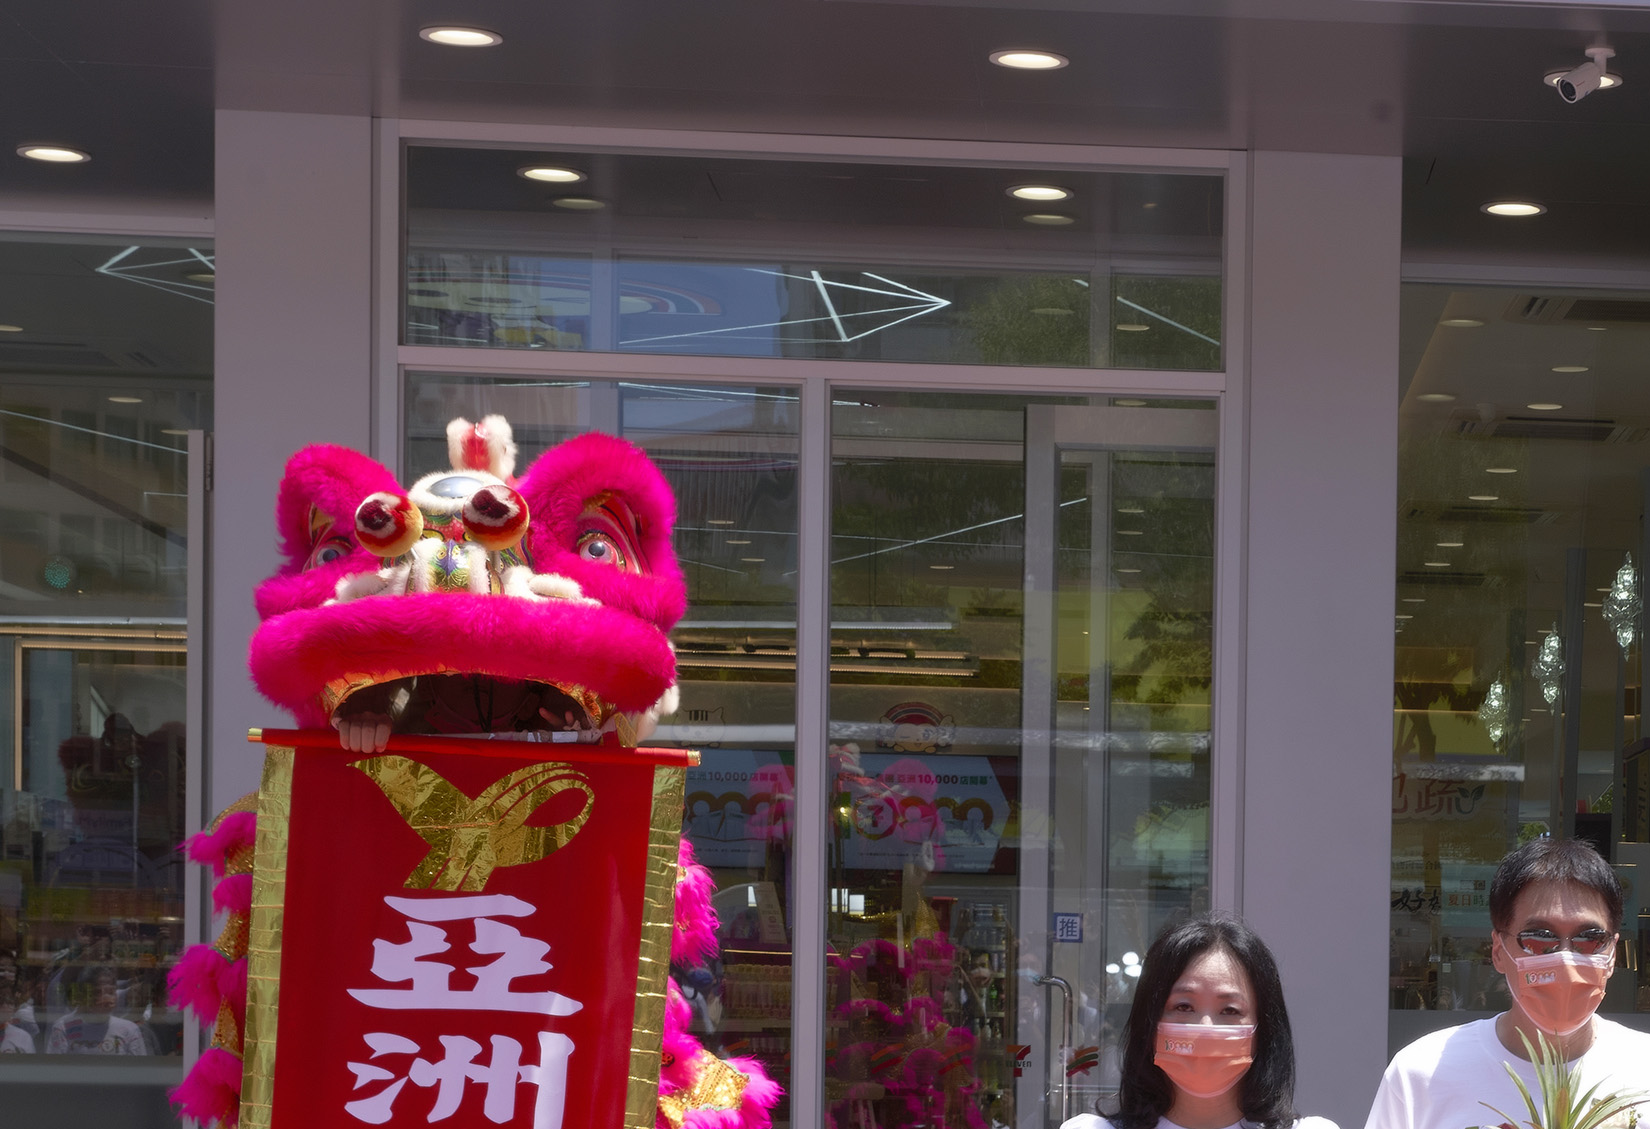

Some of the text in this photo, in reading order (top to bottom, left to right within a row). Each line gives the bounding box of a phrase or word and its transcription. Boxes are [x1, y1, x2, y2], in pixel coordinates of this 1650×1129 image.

[1448, 893, 1490, 907] 夏日時
[1059, 918, 1078, 937] 推
